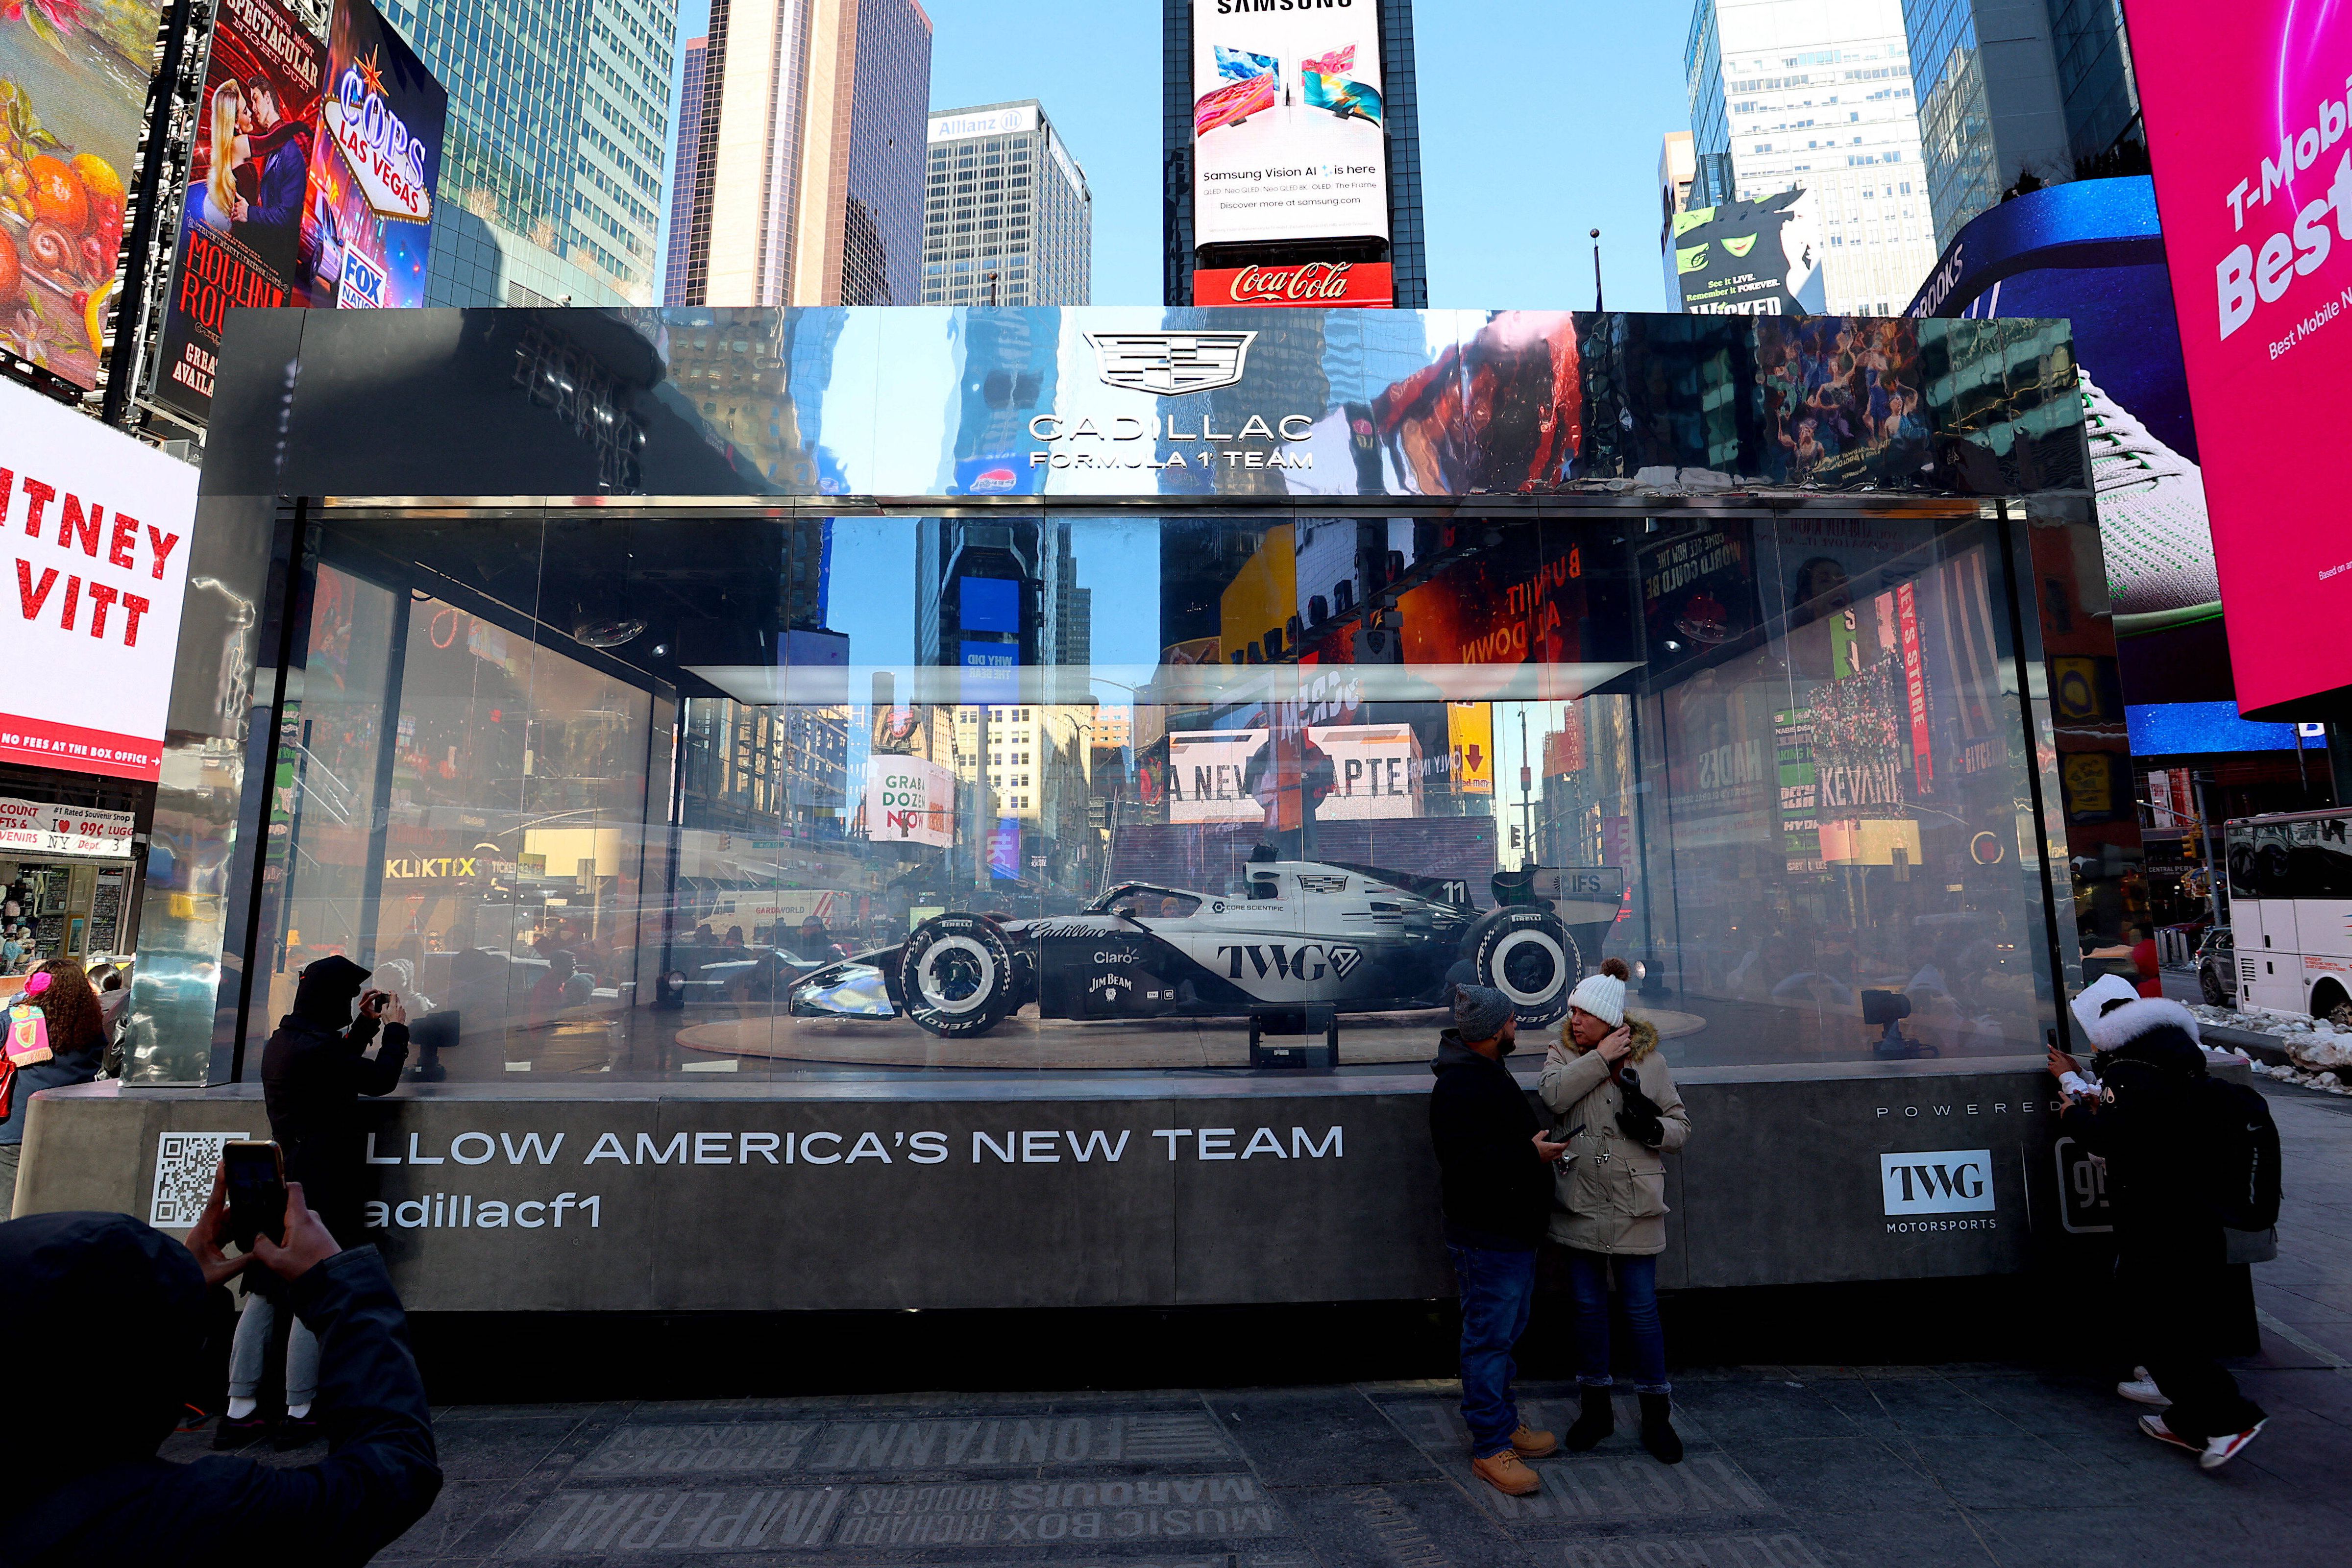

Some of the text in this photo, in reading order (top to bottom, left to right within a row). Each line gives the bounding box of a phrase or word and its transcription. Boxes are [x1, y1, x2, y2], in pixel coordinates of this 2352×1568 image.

[232, 16, 280, 65] NIGHT
[282, 64, 309, 93] OUT!
[294, 31, 315, 58] MOST
[340, 69, 427, 190] COPS
[939, 118, 996, 136] Allianz
[339, 120, 419, 214] LAS VEGAS
[1203, 164, 1376, 181] Samsung Vision AI is here
[1298, 196, 1361, 206] samsung.com
[186, 230, 272, 308] MOULIN
[345, 252, 383, 305] FOX
[1708, 273, 1756, 288] See it LIVE.
[1686, 278, 1781, 302] Remember it FOREVER.
[2268, 330, 2297, 361] Best
[2297, 302, 2340, 341] Mobile
[186, 343, 219, 376] GREA
[1029, 414, 1313, 442] CADILLAC
[1029, 450, 1313, 469] FORMULA 1 TEAM
[2318, 565, 2337, 581] Based
[2337, 564, 2346, 573] on
[1905, 649, 1925, 728] STORE
[1, 733, 147, 764] NO FEES AT THE BOX OFFICE
[885, 775, 921, 790] GRAB
[1332, 756, 1413, 798] APTE
[0, 804, 39, 817] COUNT
[882, 792, 926, 808] DOZEN
[20, 820, 27, 829] &
[64, 808, 83, 817] Rated
[85, 810, 112, 820] Souvenir
[113, 813, 130, 823] Shop
[887, 810, 924, 830] NOW
[79, 821, 104, 836] 99¢
[47, 834, 71, 850] NY
[78, 839, 101, 850] Dept.
[385, 858, 476, 878] KLIKTIX
[1442, 881, 1465, 903] 11
[1512, 913, 1542, 922] PIRELLI
[1024, 921, 1109, 939] Cadillac
[1093, 949, 1133, 964] Claro
[1218, 944, 1324, 981] TWG
[1089, 973, 1133, 993] JIM BEAM
[1516, 1013, 1549, 1023] ZER
[365, 1125, 1345, 1165] LLOW AMERICA'S NEW TEAM
[1890, 1163, 1984, 1201] TWG
[365, 1192, 601, 1229] adillacf1
[1886, 1218, 1997, 1234] MOTORSPORTS
[809, 1417, 1125, 1469] FONTANNE
[853, 1485, 1000, 1514] RODGERS
[1009, 1477, 1254, 1509] MARQUIS
[530, 1490, 835, 1551] IMPERIAL
[838, 1513, 991, 1544] RICHARD
[1007, 1504, 1273, 1541] MUSIC BOX
